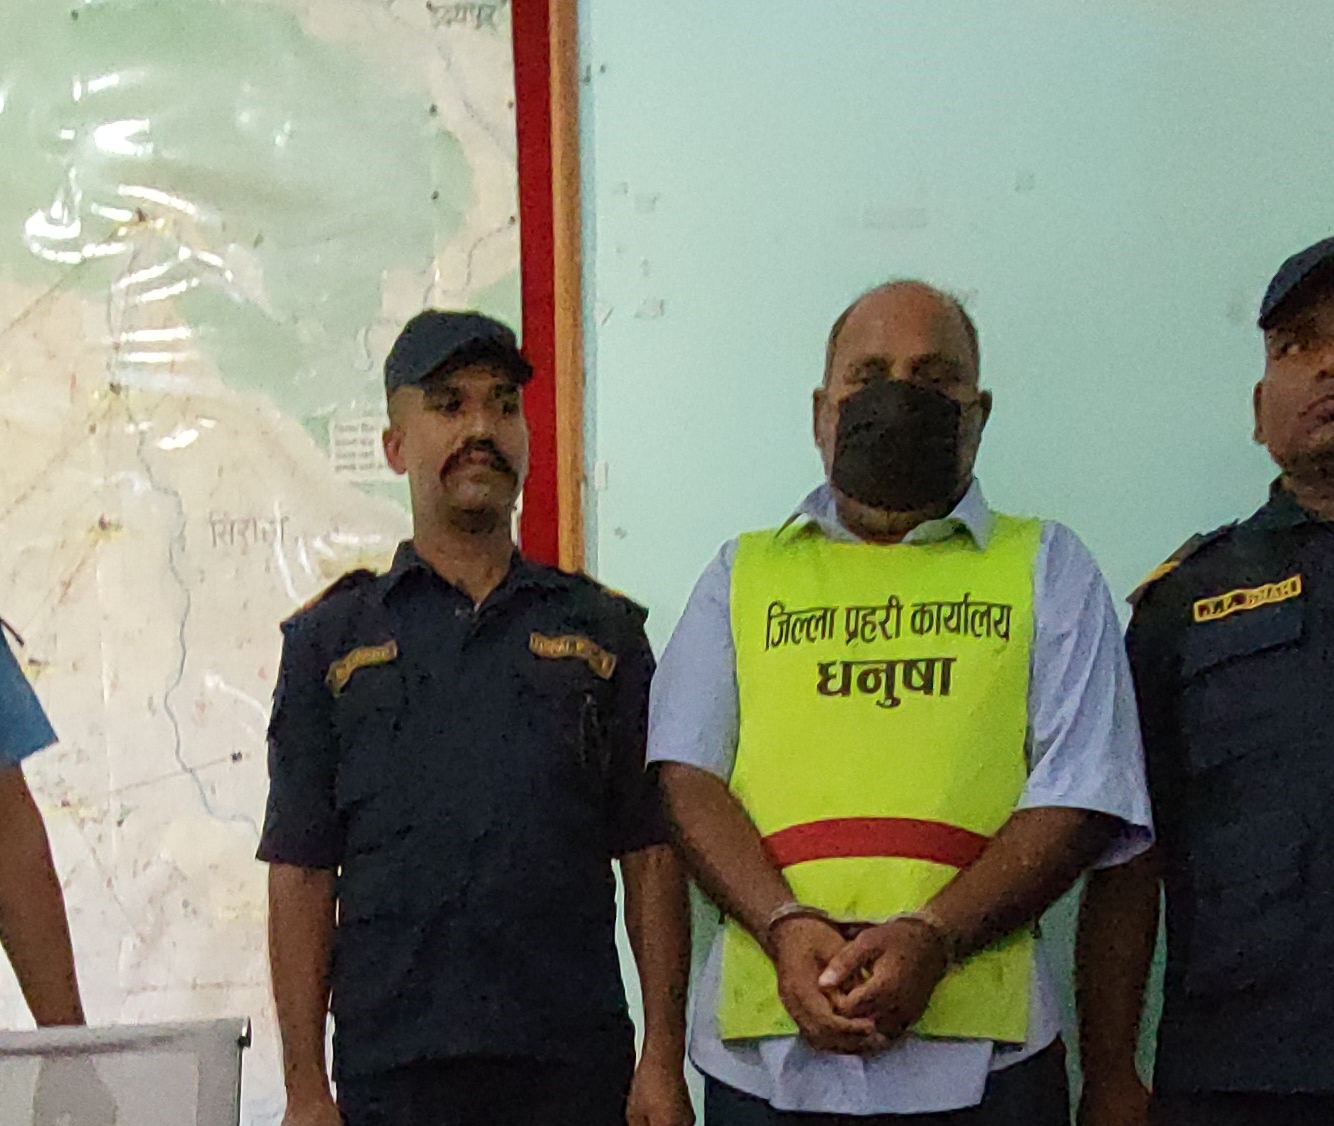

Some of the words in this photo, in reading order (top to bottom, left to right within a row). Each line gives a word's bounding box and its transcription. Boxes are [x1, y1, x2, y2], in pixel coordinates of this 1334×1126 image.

[765, 600, 839, 651] जिल्ला
[844, 594, 904, 646] प्रहरी
[910, 592, 1013, 642] कार्यालय
[817, 656, 957, 708] धनुषा
